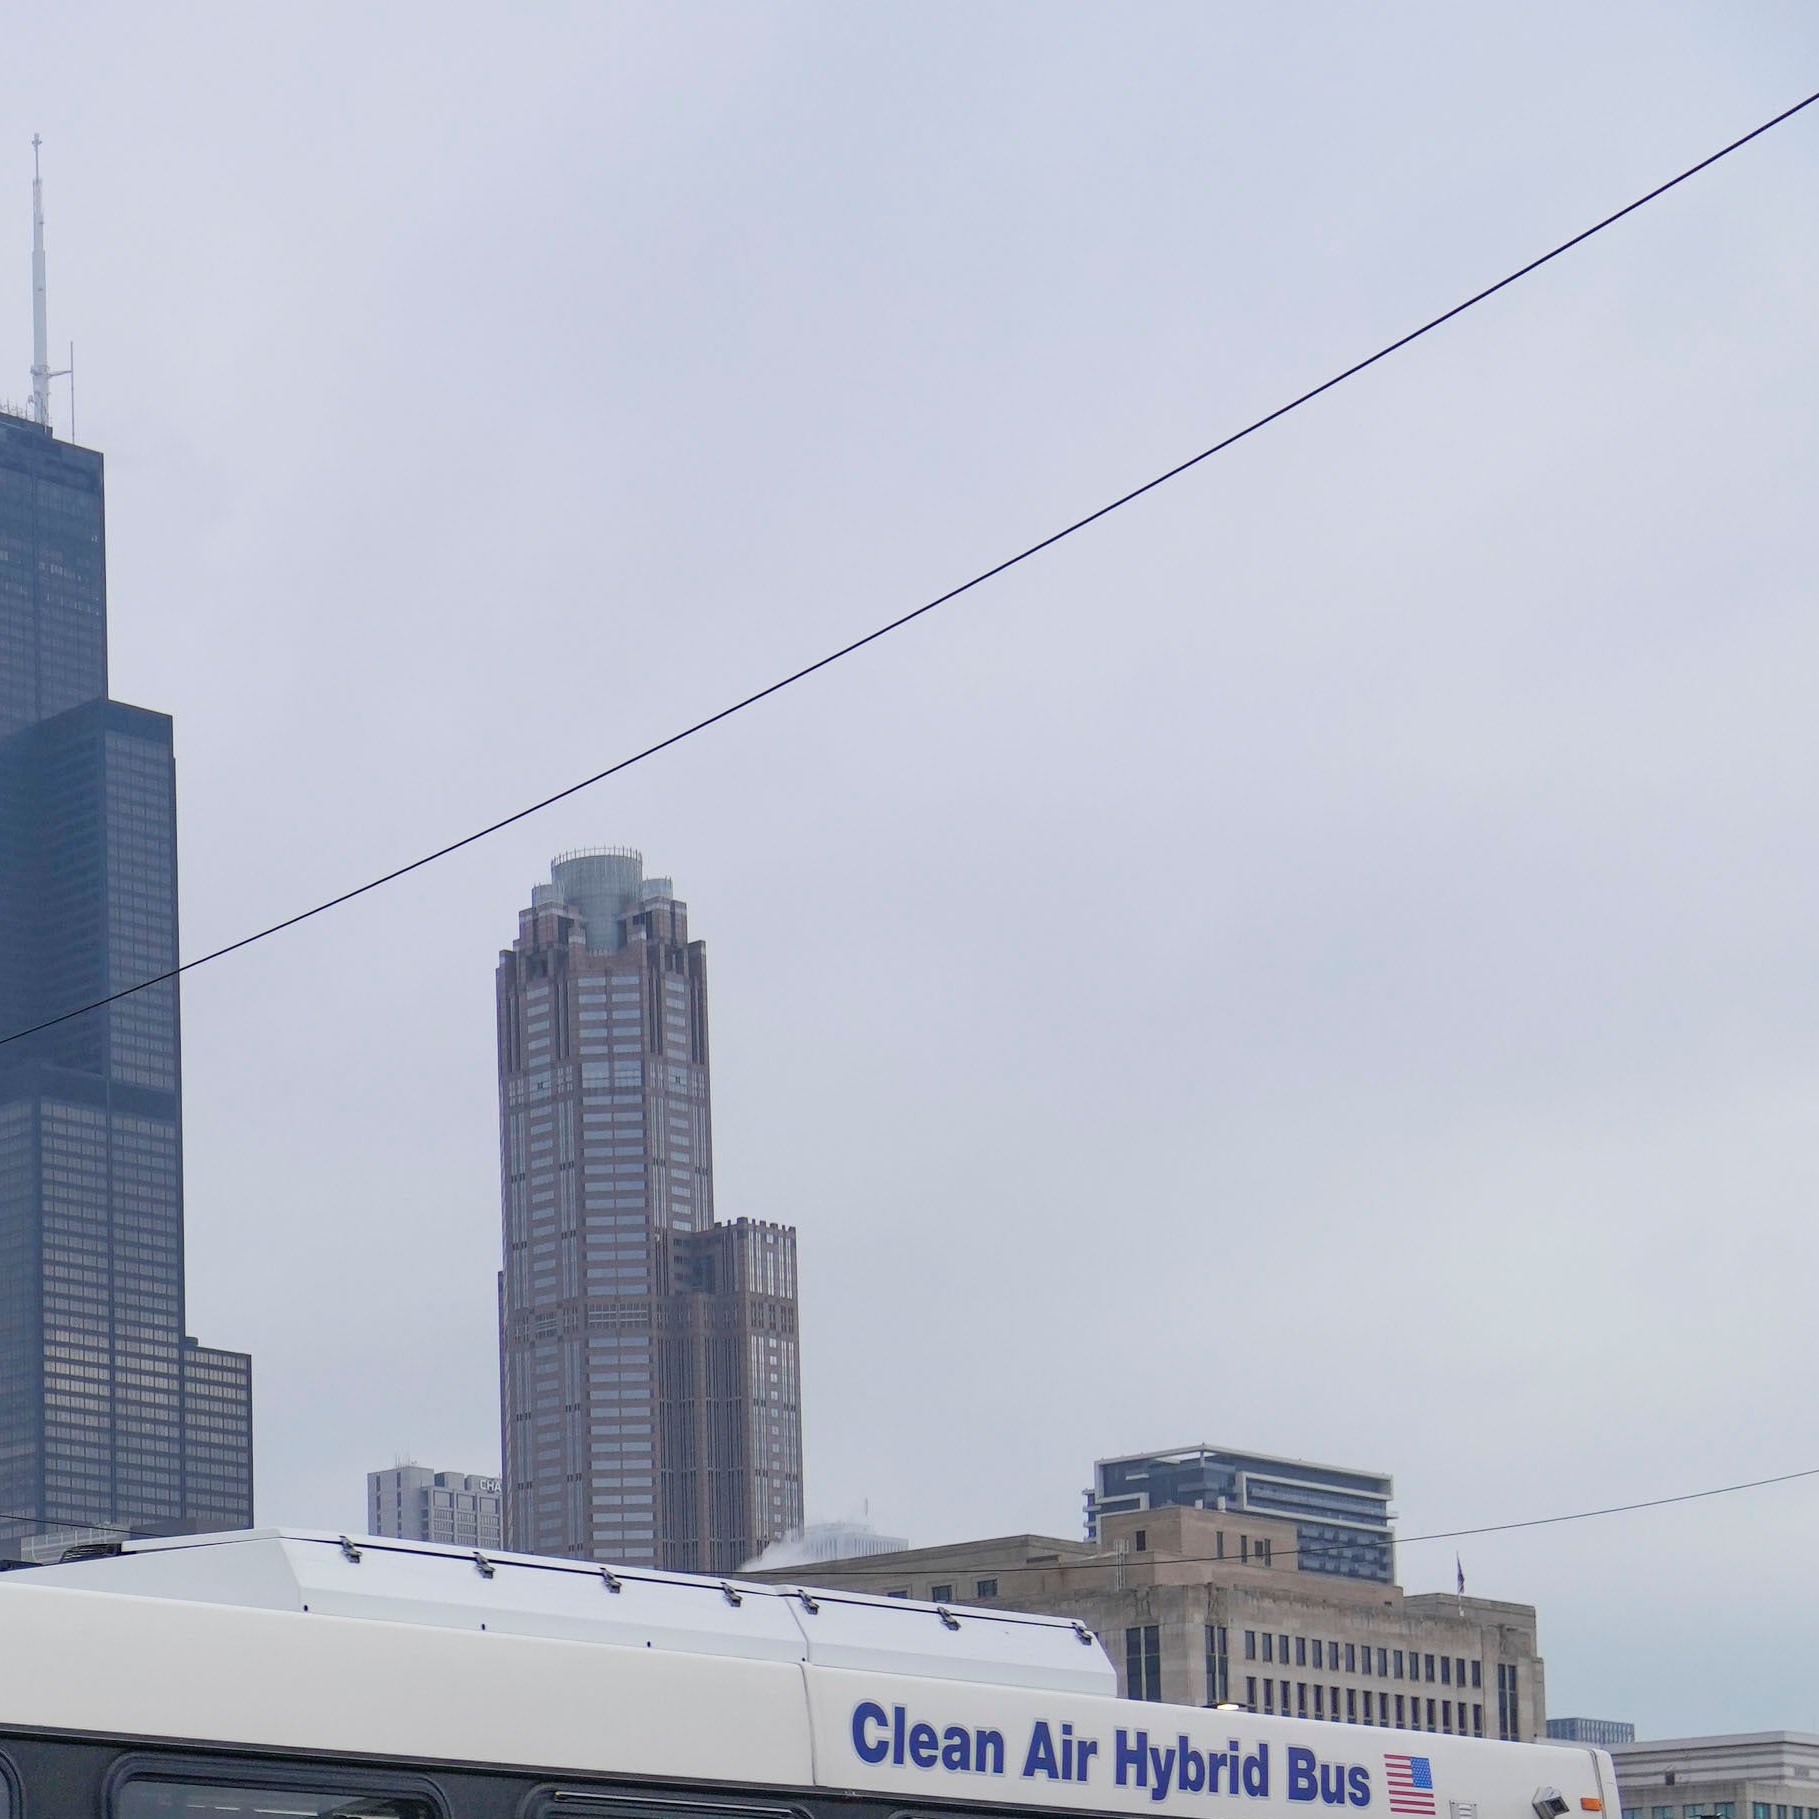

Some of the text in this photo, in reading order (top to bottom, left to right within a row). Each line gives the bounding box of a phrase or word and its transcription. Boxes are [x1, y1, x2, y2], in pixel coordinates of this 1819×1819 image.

[852, 1701, 1372, 1808] Clean Air Hybrid Bus
